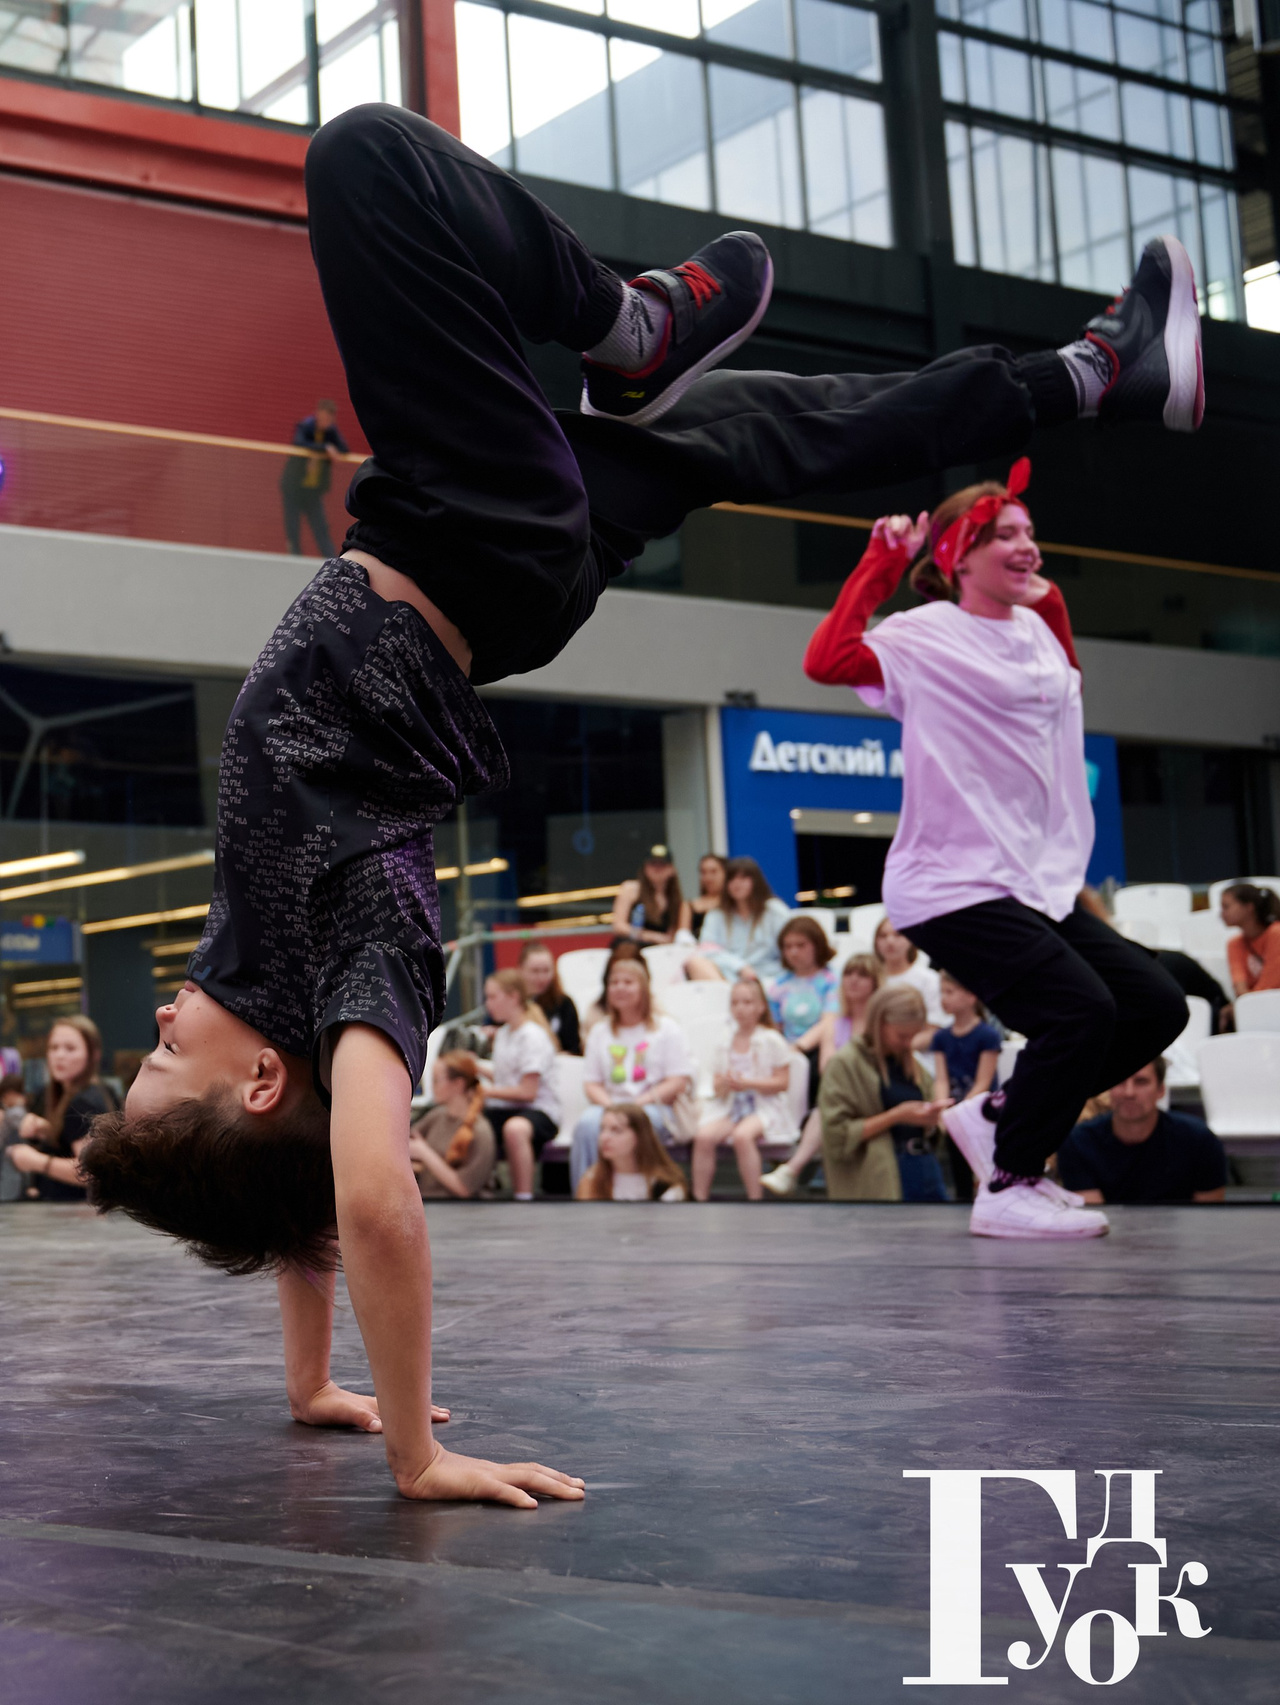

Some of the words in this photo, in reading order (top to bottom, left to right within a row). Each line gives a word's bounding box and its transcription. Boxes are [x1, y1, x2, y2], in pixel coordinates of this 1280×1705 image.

[319, 586, 333, 596] FILA
[335, 583, 348, 593] FILA
[322, 600, 339, 610] FILA
[341, 602, 356, 614] FILA
[351, 598, 367, 610] FILA
[323, 610, 340, 623] FILA
[336, 622, 351, 635] FILA
[291, 639, 307, 648] FILA
[373, 656, 391, 672] FILA
[365, 663, 383, 679] FILA
[313, 680, 332, 692] FILA
[370, 678, 389, 694] FILA
[384, 678, 402, 694] FILA
[305, 687, 322, 699] FILA
[372, 691, 390, 707] FILA
[388, 693, 405, 710] FILA
[316, 700, 335, 711] FILA
[279, 712, 294, 720] FILA
[296, 714, 316, 725] FILA
[400, 711, 414, 728] FILA
[272, 726, 292, 737] FILA
[313, 729, 334, 740] FILA
[266, 737, 285, 747] FILA
[297, 733, 315, 744] FILA
[288, 740, 307, 749] FILA
[325, 741, 345, 753] FILA
[280, 746, 299, 756] FILA
[310, 746, 330, 757] FILA
[749, 730, 886, 777] Детский
[293, 756, 314, 769] FILA
[303, 751, 323, 764] FILA
[232, 766, 244, 774] FILA
[373, 758, 394, 773] FILA
[235, 788, 249, 796] FILA
[419, 802, 440, 812] FILA
[356, 809, 376, 819] FILA
[381, 812, 400, 821] FILA
[406, 811, 426, 819] FILA
[234, 817, 248, 825] FILA
[261, 817, 279, 825] FILA
[267, 827, 284, 835] FILA
[377, 825, 396, 836] FILA
[264, 838, 281, 846] FILA
[302, 833, 322, 842] FILA
[248, 840, 264, 849] FILA
[306, 843, 327, 851] FILA
[244, 848, 260, 857] FILA
[262, 849, 280, 857] FILA
[304, 854, 321, 863] FILA
[362, 854, 380, 867] FILA
[276, 862, 292, 870] FILA
[362, 862, 380, 877] FILA
[256, 868, 275, 876] FILA
[276, 870, 291, 879] FILA
[264, 878, 282, 886] FILA
[343, 870, 362, 887] FILA
[365, 871, 383, 886] FILA
[261, 890, 279, 898] FILA
[277, 886, 294, 895] FILA
[345, 883, 365, 899] FILA
[357, 886, 376, 902] FILA
[373, 885, 391, 902] FILA
[270, 902, 289, 910] FILA
[337, 901, 355, 918] FILA
[359, 902, 378, 919] FILA
[285, 914, 302, 922] FILA
[374, 906, 391, 923] FILA
[283, 929, 302, 938] FILA
[365, 923, 385, 939] FILA
[260, 938, 276, 948] FILA
[288, 948, 306, 957] FILA
[260, 963, 277, 972] FILA
[270, 958, 286, 968] FILA
[356, 961, 376, 970] FILA
[273, 973, 288, 984] FILA
[330, 970, 350, 986] FILA
[371, 976, 391, 988] FILA
[264, 980, 280, 989] FILA
[351, 980, 372, 990] FILA
[251, 985, 268, 995] FILA
[350, 988, 371, 997] FILA
[223, 1000, 241, 1012] FILA
[235, 996, 252, 1006] FILA
[256, 998, 274, 1008] FILA
[248, 1008, 267, 1019] FILA
[381, 1007, 399, 1025] FILA
[255, 1018, 274, 1030] FILA
[272, 1015, 290, 1025] FILA
[272, 1033, 290, 1044] FILA
